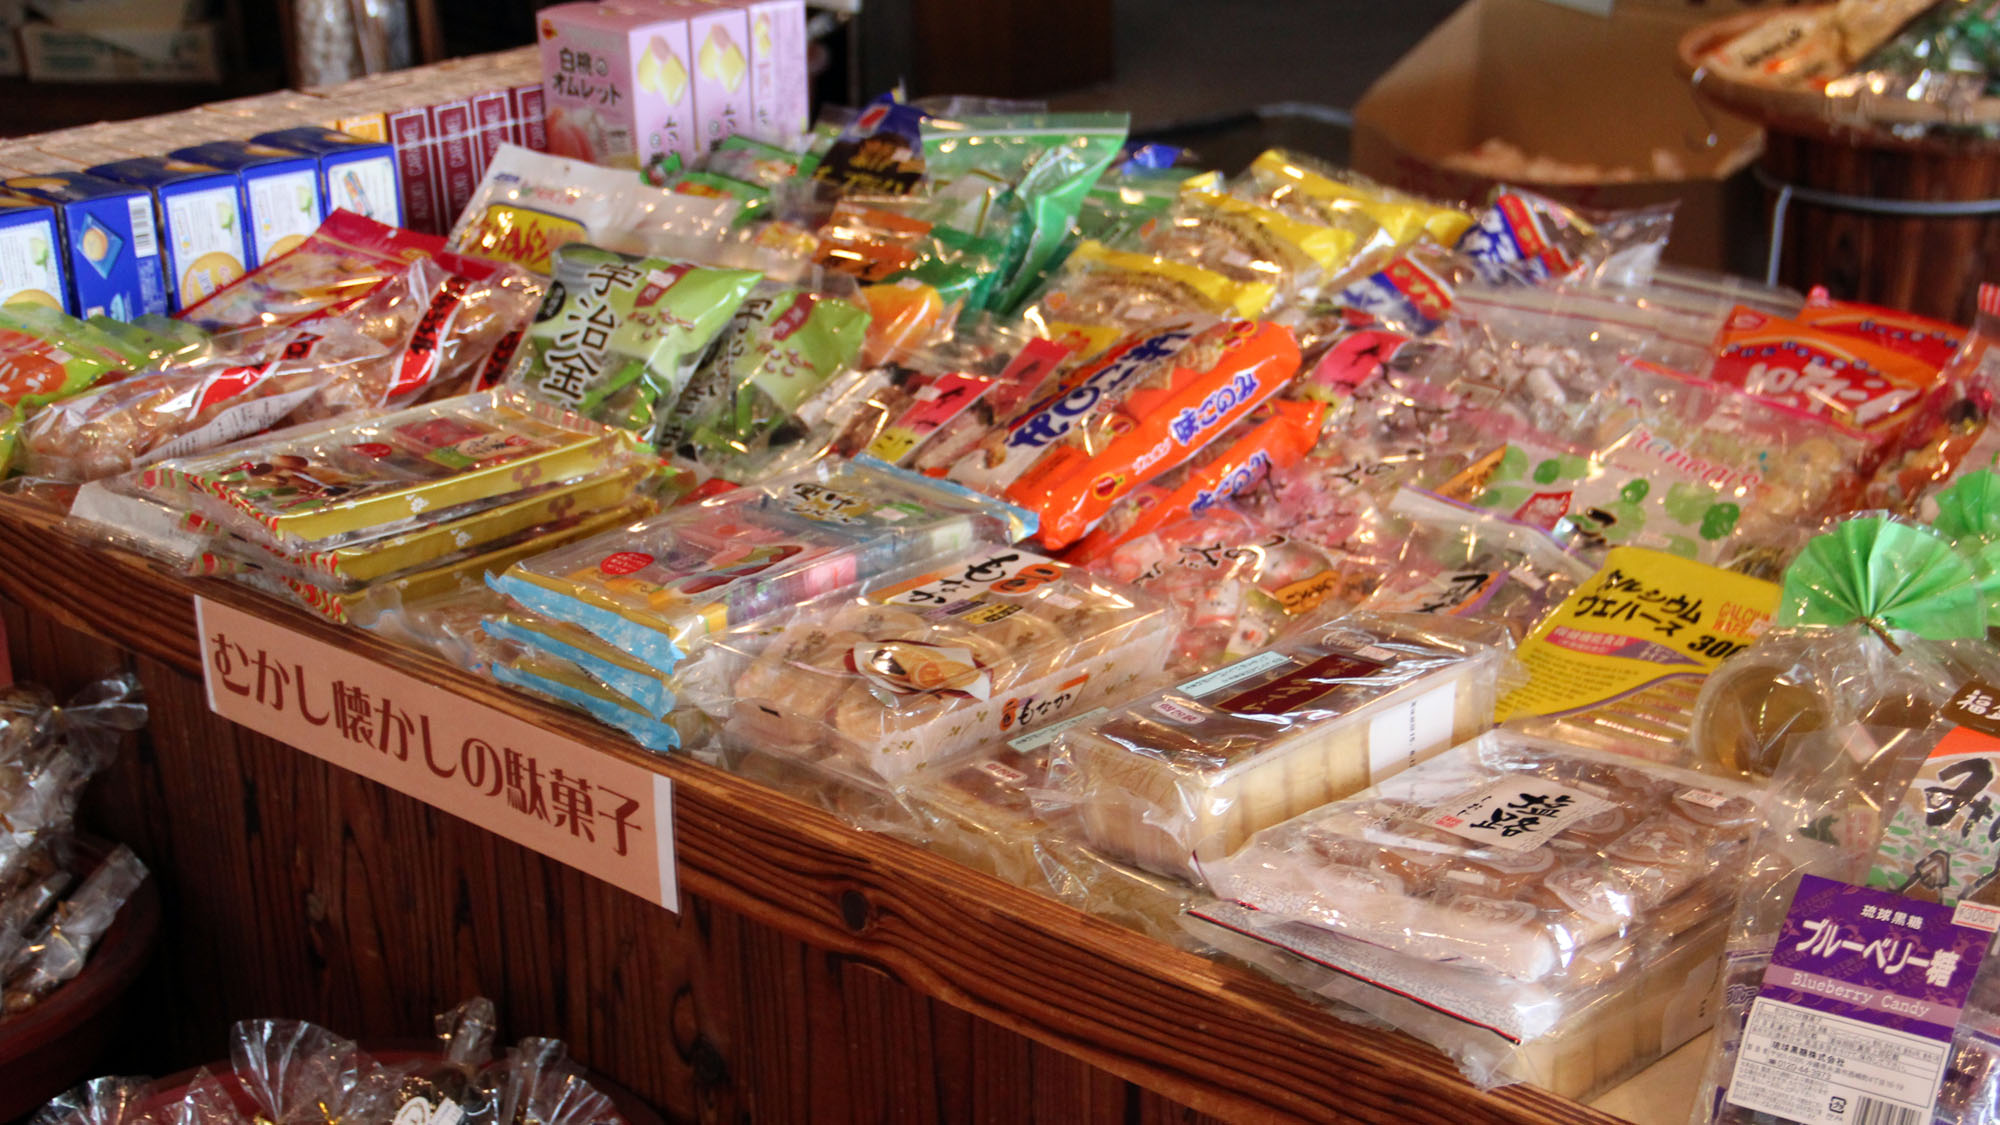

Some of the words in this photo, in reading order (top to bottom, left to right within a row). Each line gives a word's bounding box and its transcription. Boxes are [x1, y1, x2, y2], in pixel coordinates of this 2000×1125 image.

[553, 74, 621, 105] オムレット
[211, 632, 643, 857] むかし懐かしの駄菓子
[1860, 904, 1925, 931] 琉球黒糖
[1795, 918, 1961, 988] ブルーベリー糖
[1791, 971, 1874, 1006] Blueberry
[1881, 994, 1931, 1018] Candy
